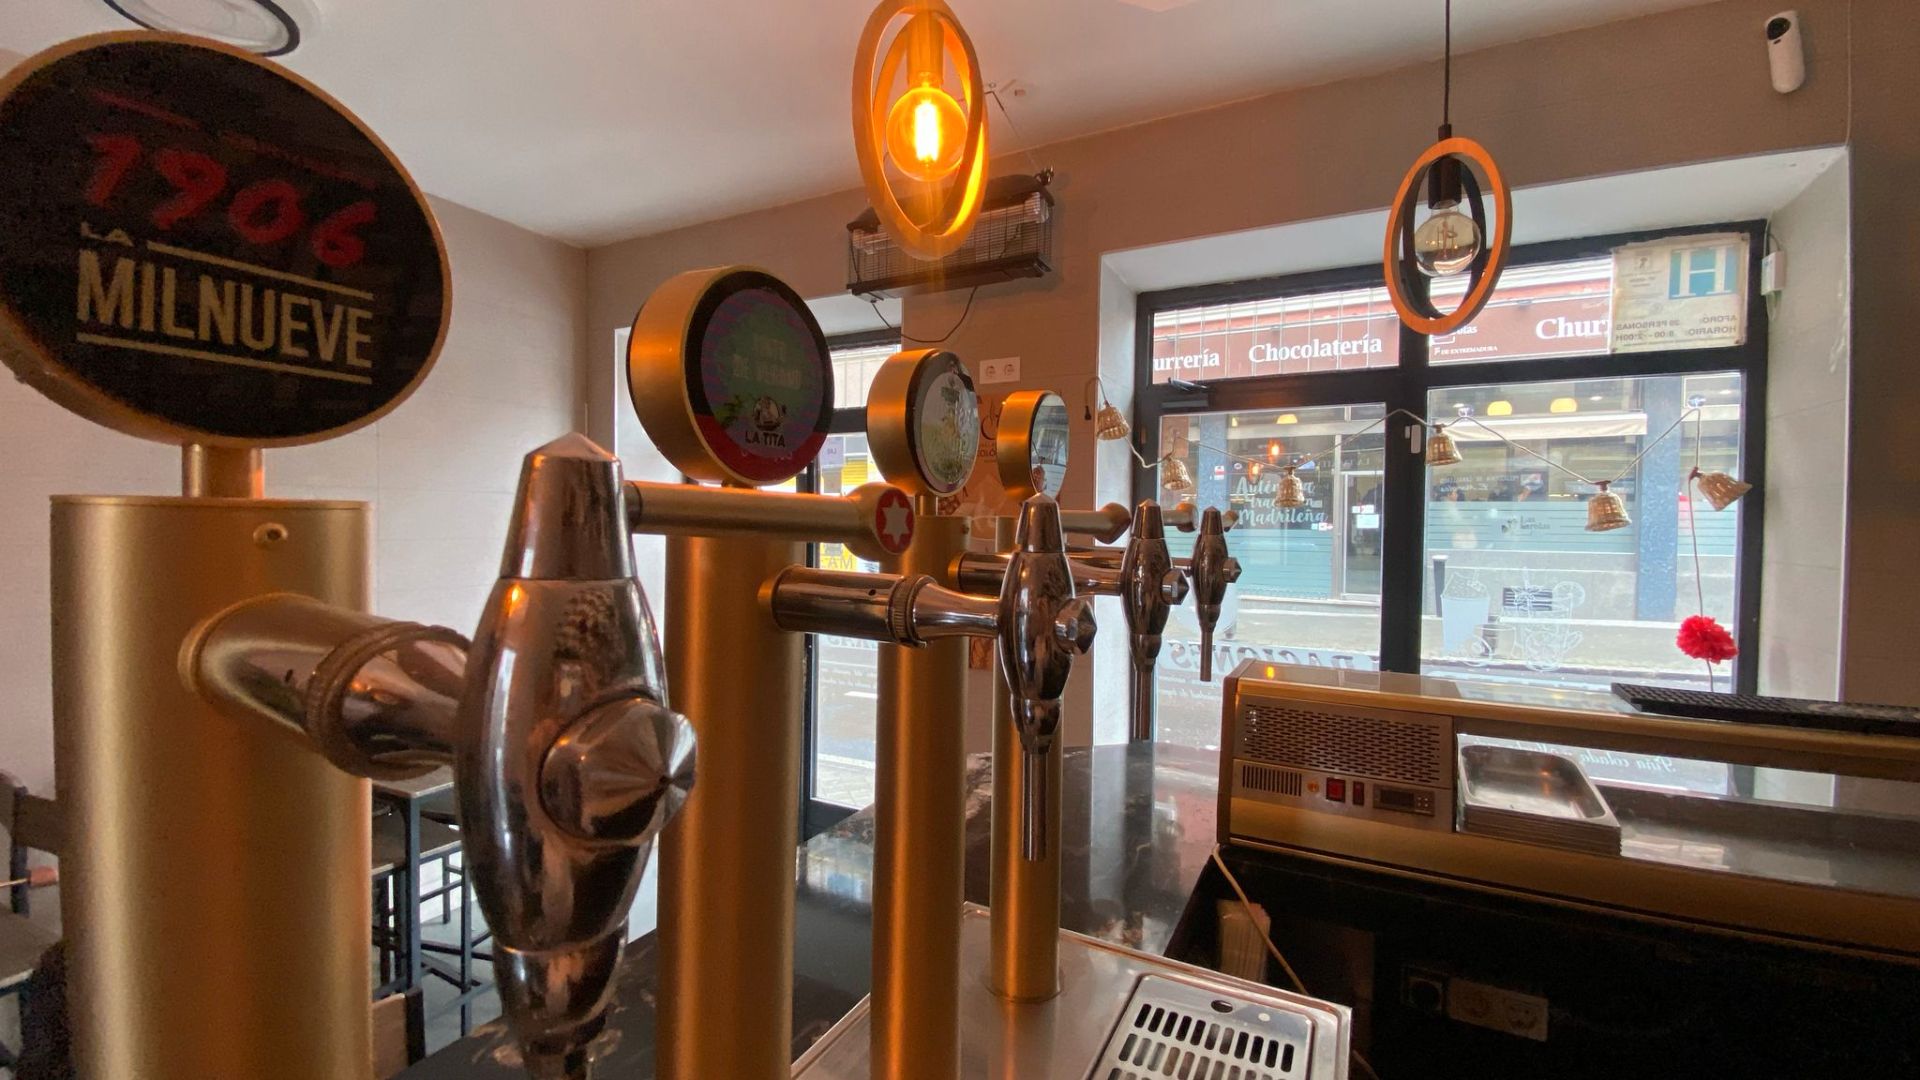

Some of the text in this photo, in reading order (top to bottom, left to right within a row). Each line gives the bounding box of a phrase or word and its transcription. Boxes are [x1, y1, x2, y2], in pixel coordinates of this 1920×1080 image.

[86, 133, 376, 268] 1906
[77, 248, 372, 368] MILNUEVE
[1153, 333, 1382, 371] urrería Chocolatería
[745, 430, 786, 448] LA TITA
[1236, 475, 1315, 495] Auténa
[1238, 509, 1328, 527] Madrileña
